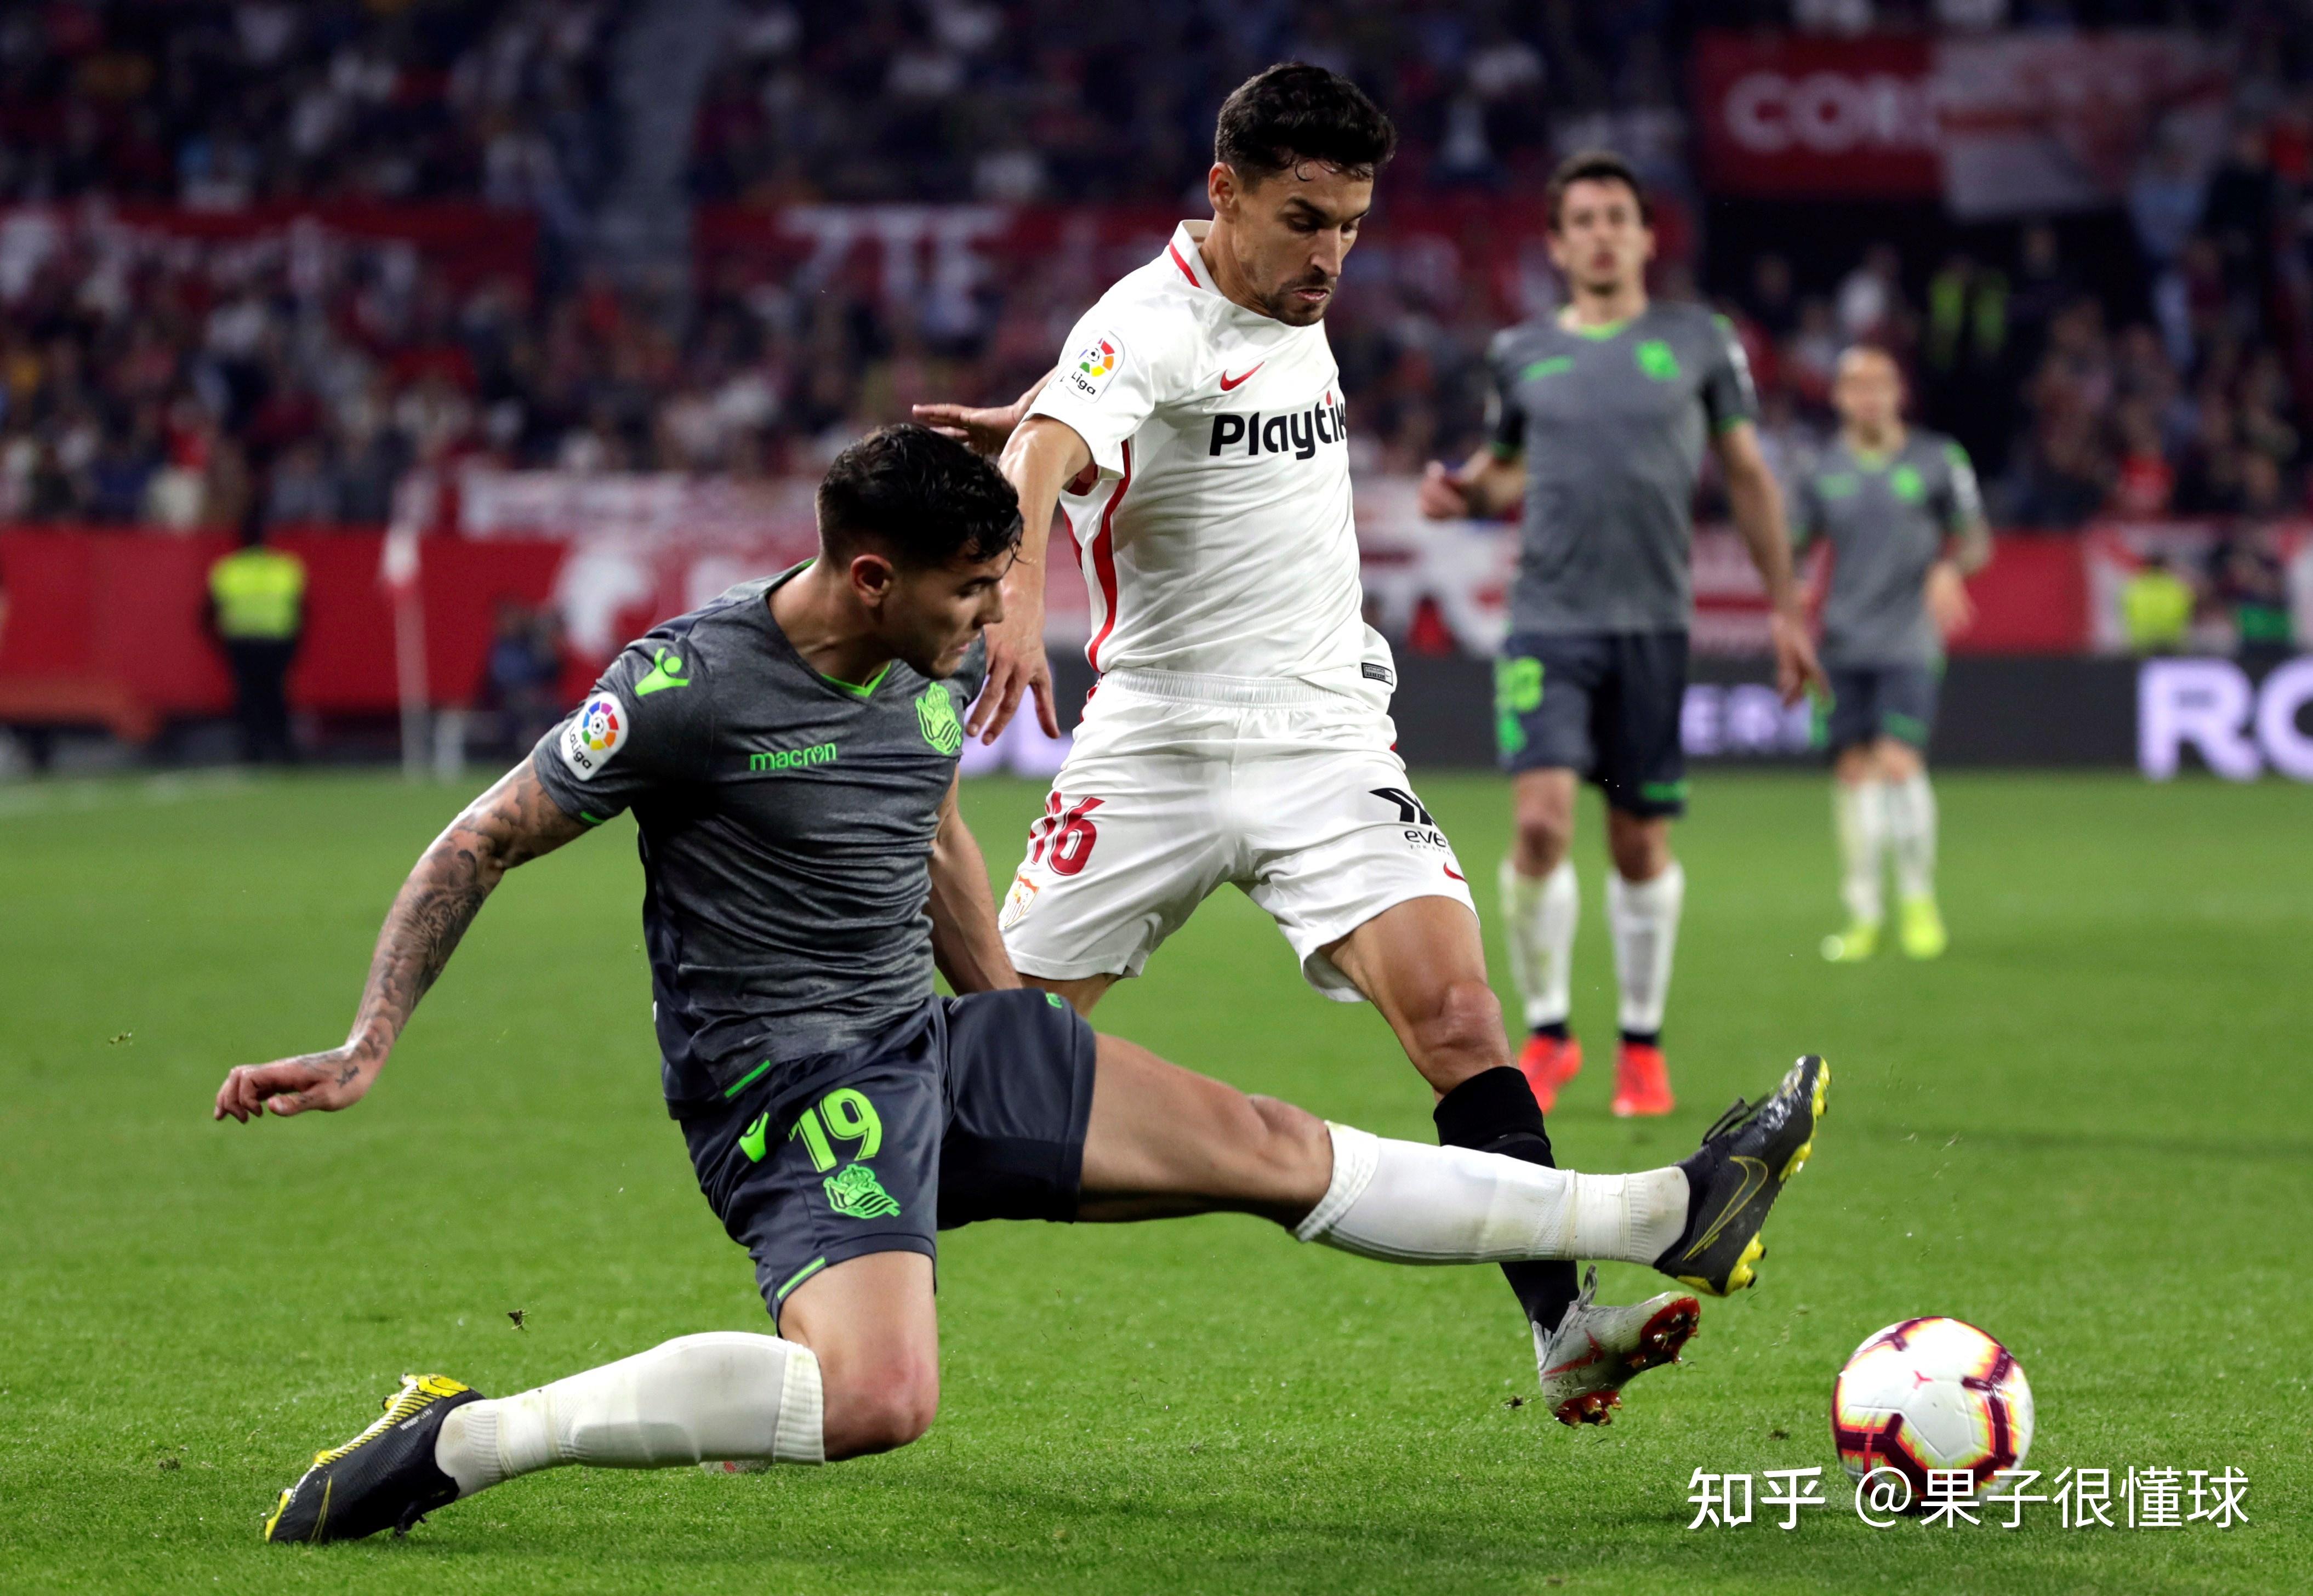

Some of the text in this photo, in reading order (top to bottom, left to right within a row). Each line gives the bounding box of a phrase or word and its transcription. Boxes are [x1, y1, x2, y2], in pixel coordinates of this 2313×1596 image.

[569, 726, 593, 771] LaLiga
[750, 742, 836, 771] macron
[788, 1087, 883, 1173] 19
